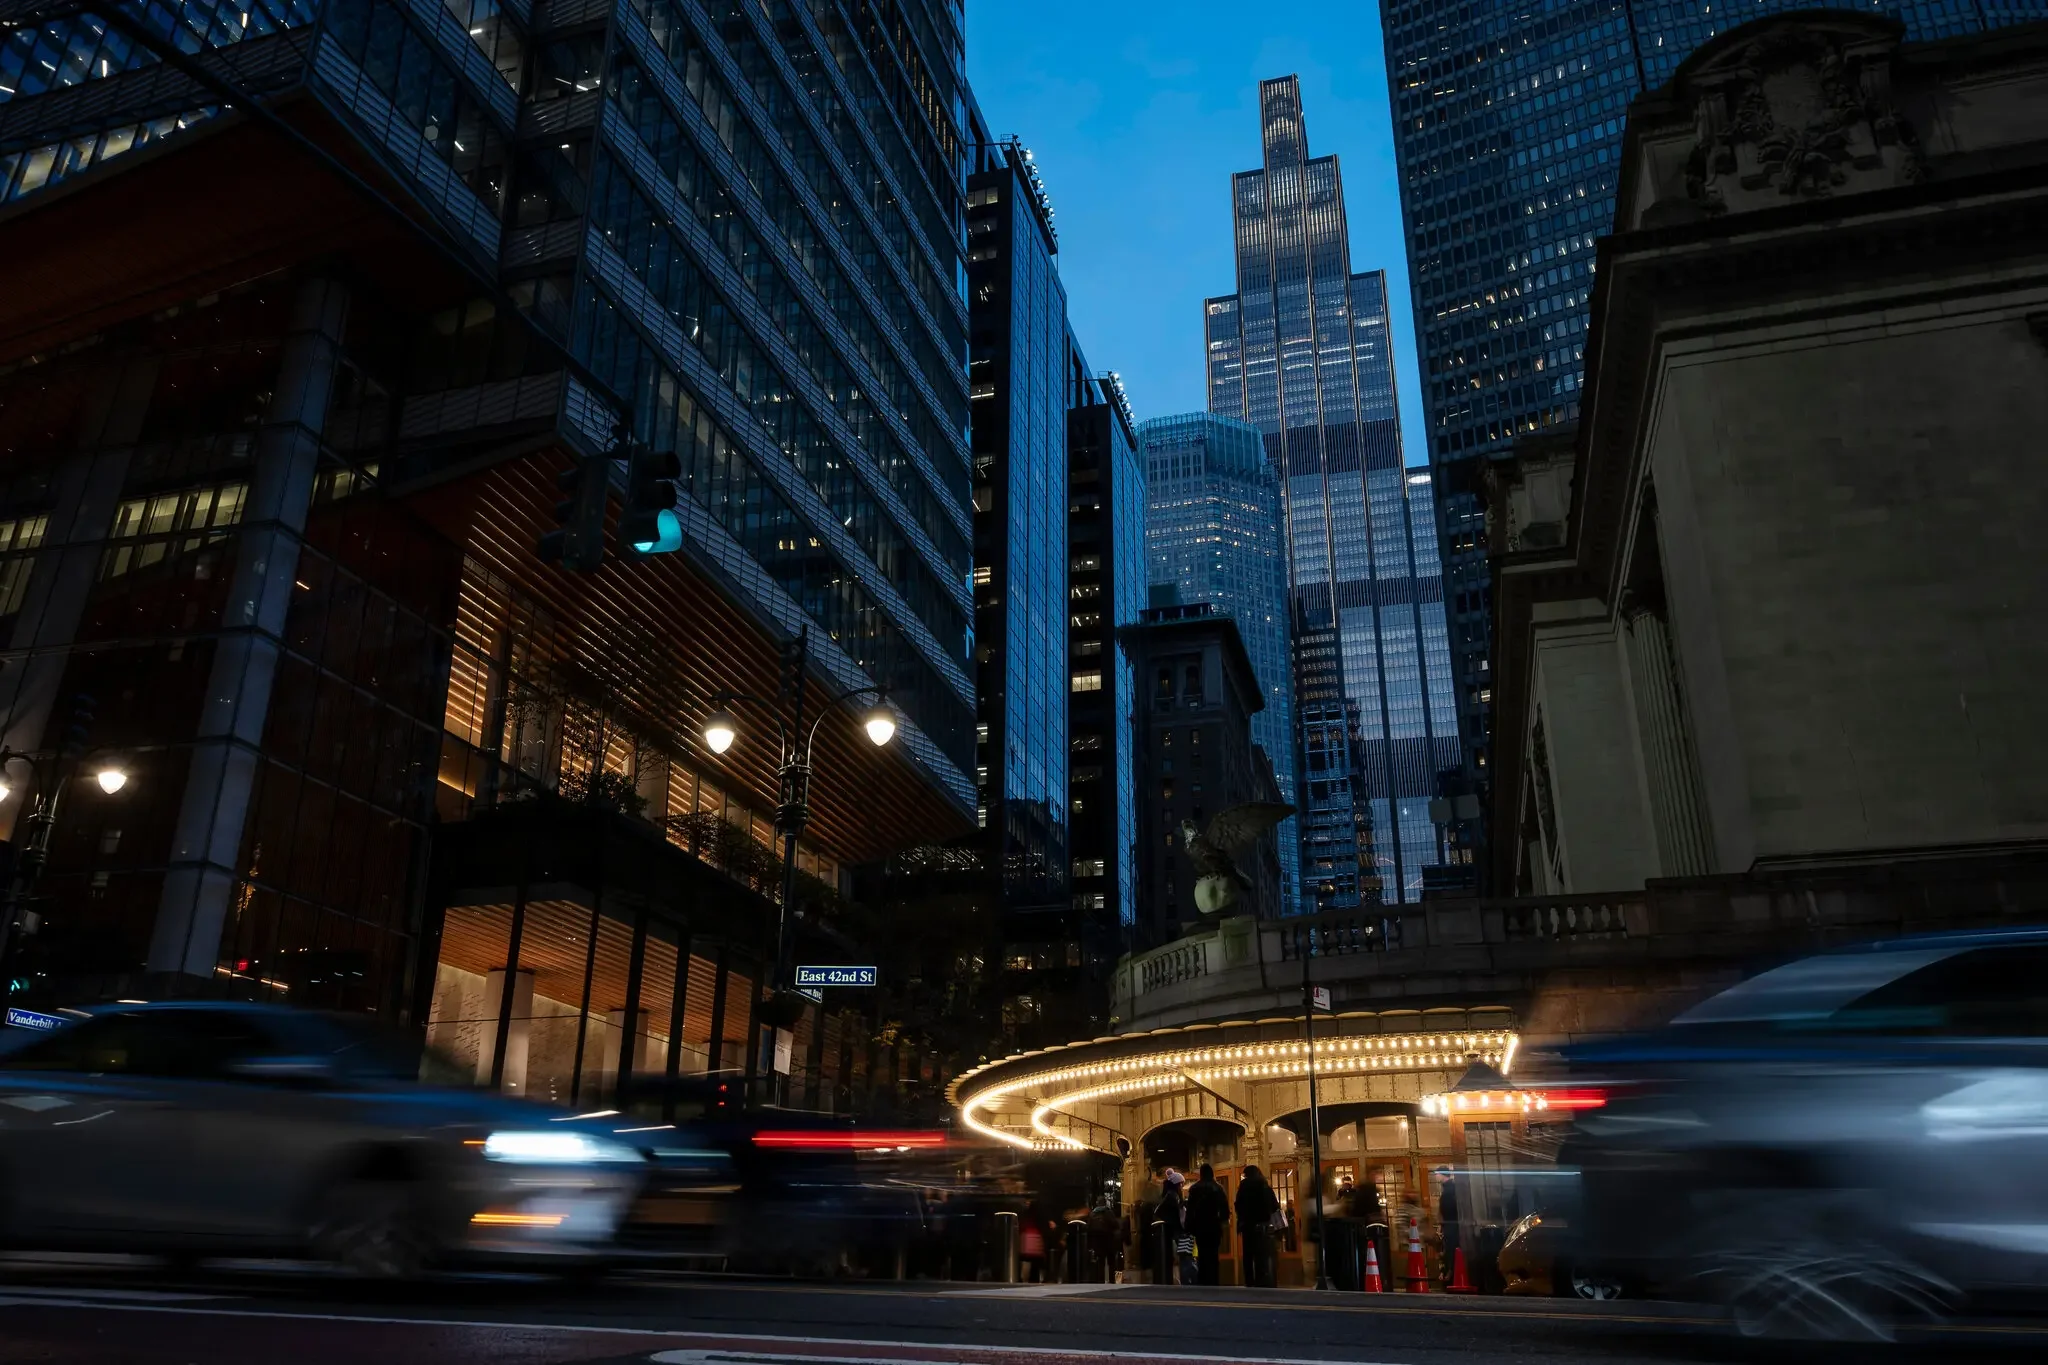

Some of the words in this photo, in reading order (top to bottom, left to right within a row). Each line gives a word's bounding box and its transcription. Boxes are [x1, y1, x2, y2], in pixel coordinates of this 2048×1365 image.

[800, 970, 826, 982] East
[828, 970, 857, 982] 42nd
[859, 970, 873, 982] St
[9, 1011, 54, 1029] Vanderbilt
